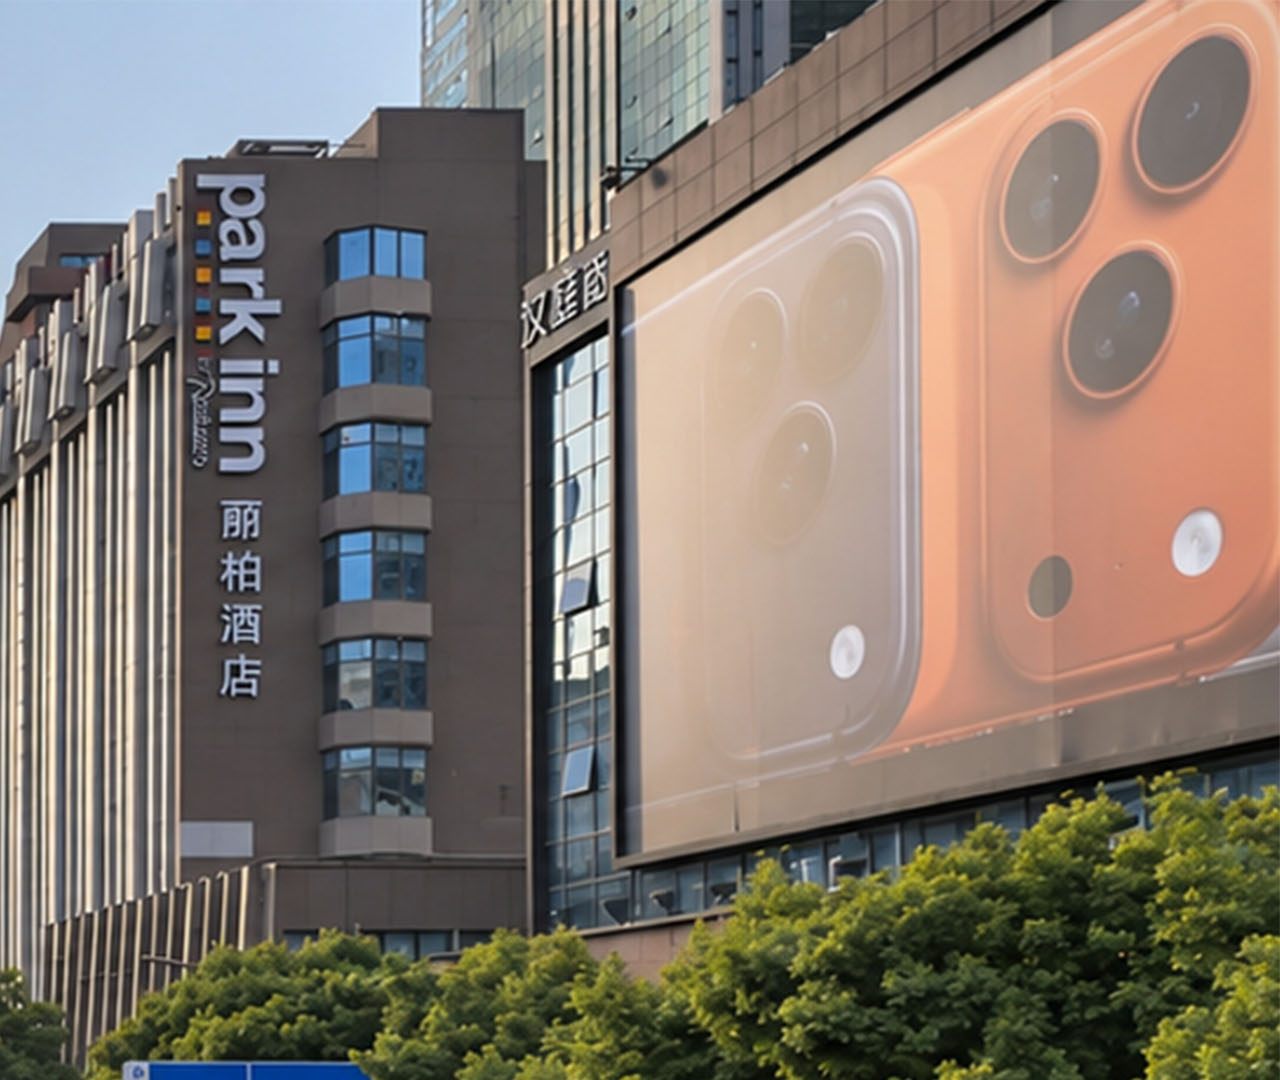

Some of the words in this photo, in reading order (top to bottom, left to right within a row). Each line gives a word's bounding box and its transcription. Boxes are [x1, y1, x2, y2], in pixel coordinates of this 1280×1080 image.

[196, 173, 282, 346] park
[218, 358, 280, 475] inn
[219, 498, 263, 698] 丽柏酒店
